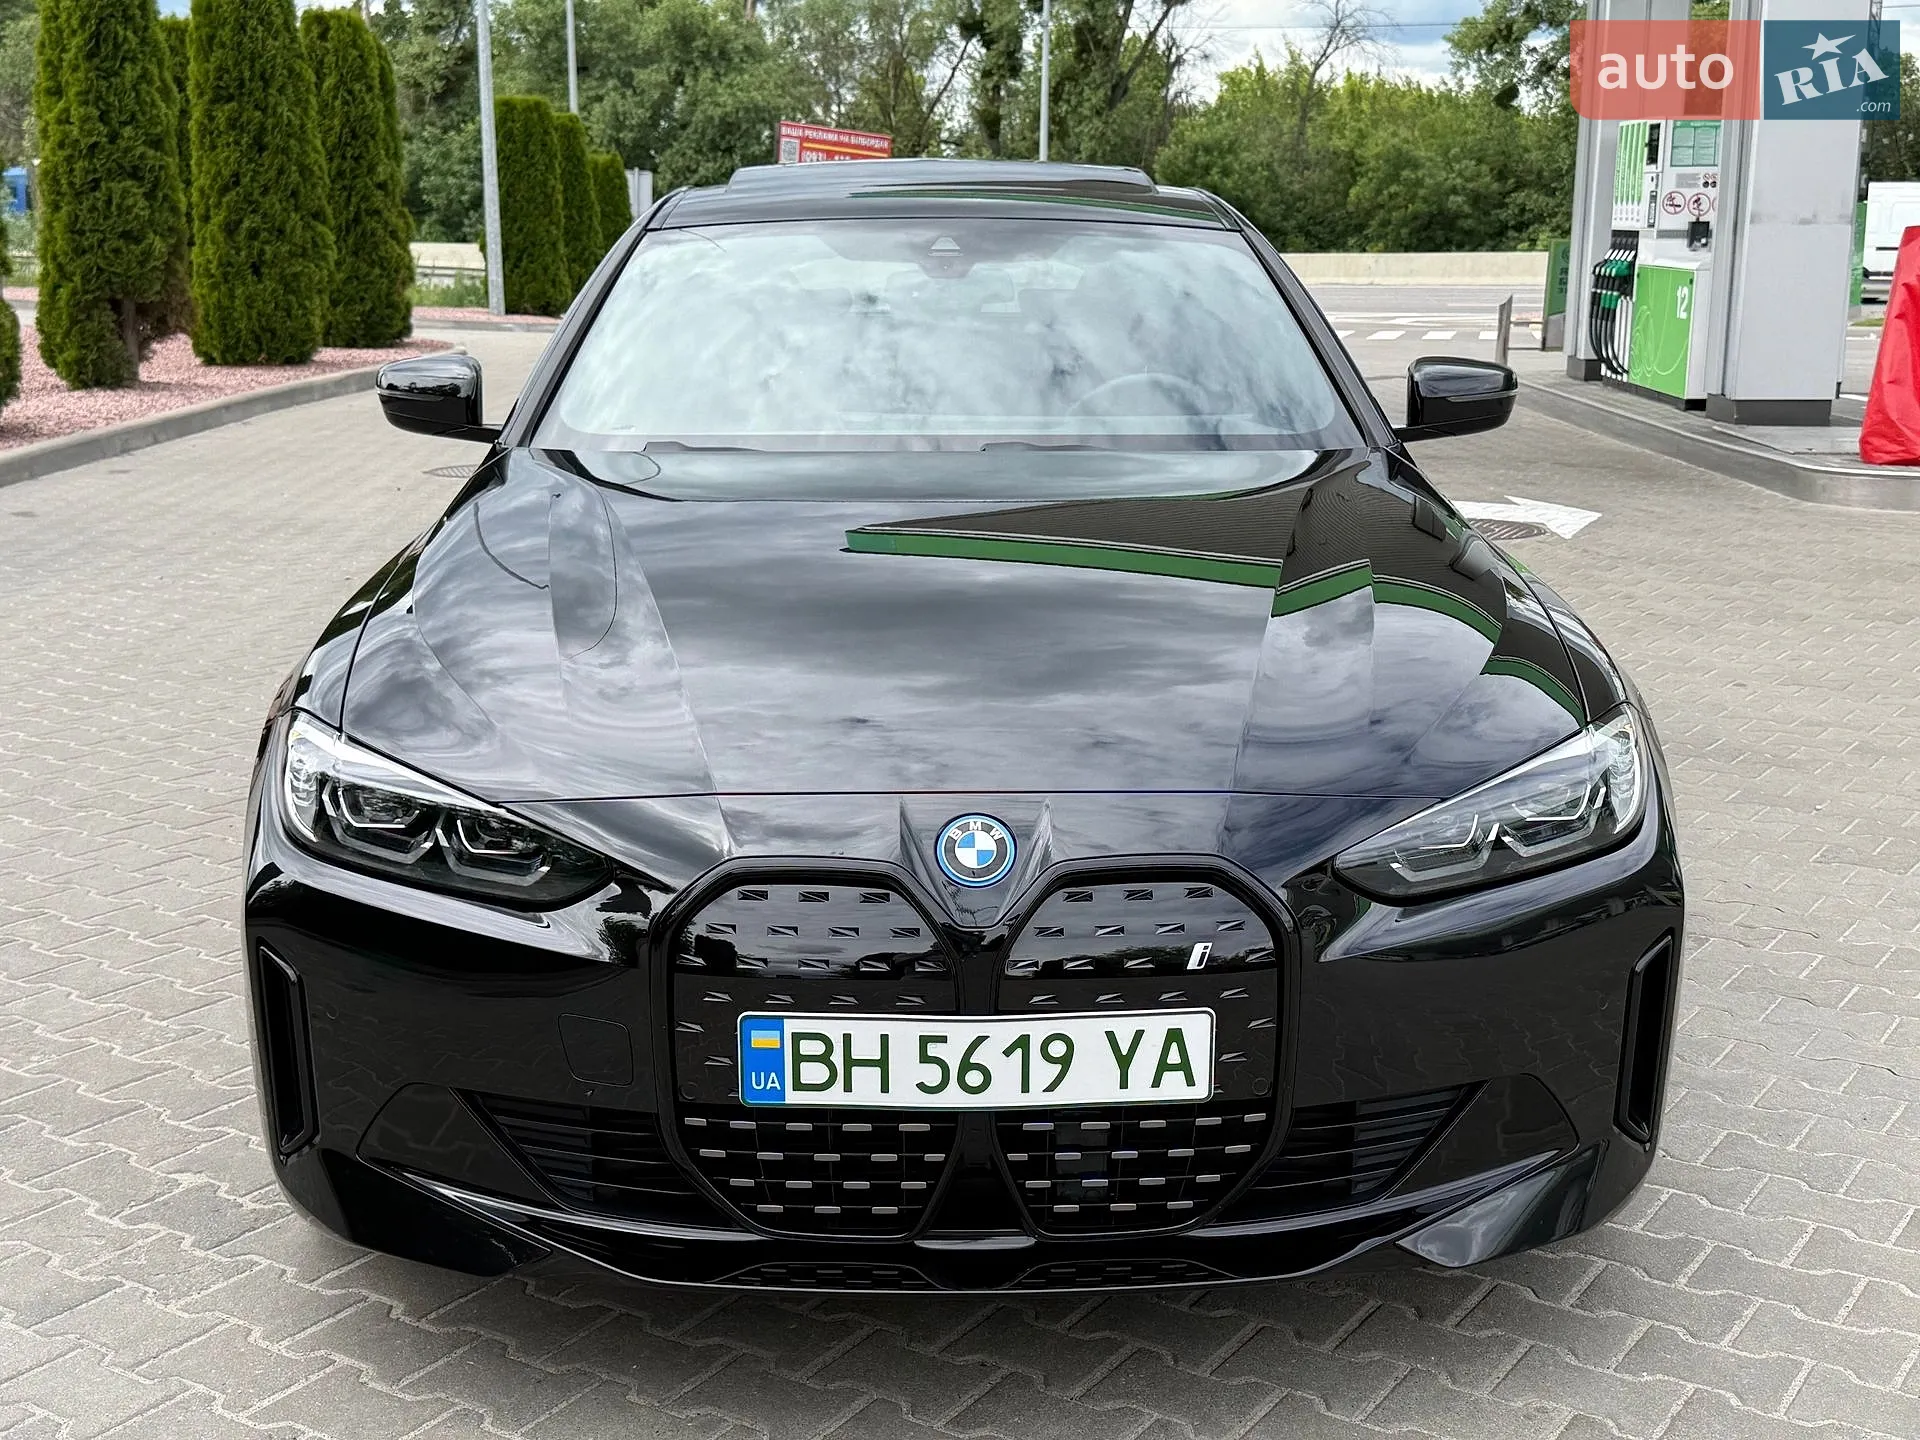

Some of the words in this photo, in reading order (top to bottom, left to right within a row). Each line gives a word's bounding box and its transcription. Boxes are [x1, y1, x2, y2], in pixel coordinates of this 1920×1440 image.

[1676, 285, 1689, 320] 12
[947, 820, 1005, 841] BMW
[791, 1031, 890, 1094] BH
[915, 1031, 1075, 1095] 5619
[1104, 1027, 1196, 1090] YA
[751, 1072, 781, 1091] UA
